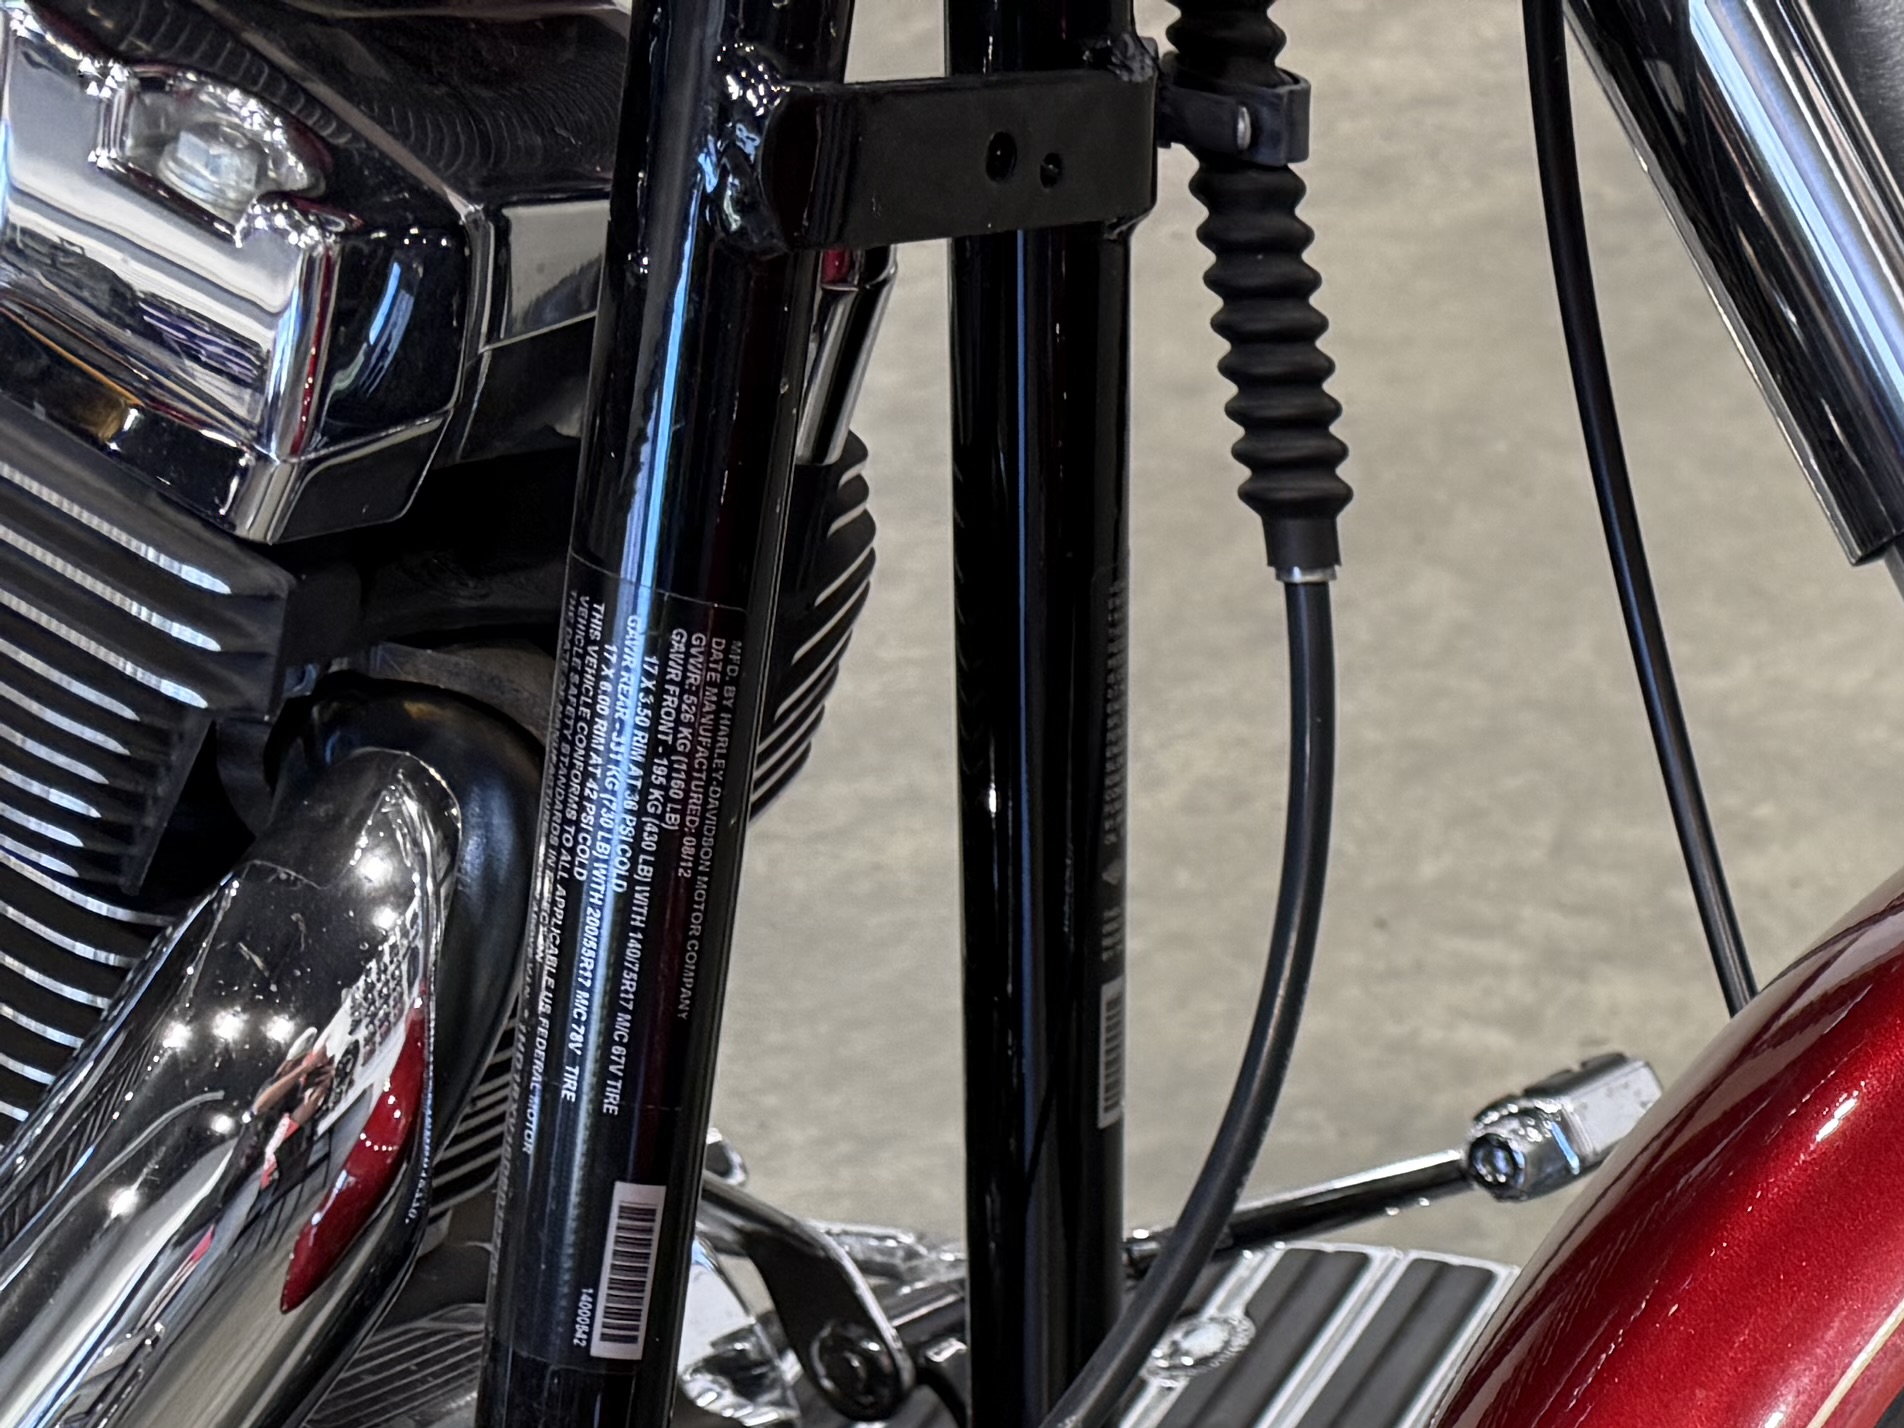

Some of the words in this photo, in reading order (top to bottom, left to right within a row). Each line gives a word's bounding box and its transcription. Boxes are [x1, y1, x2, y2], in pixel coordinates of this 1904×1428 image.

[570, 595, 590, 670] VEHICLE
[587, 601, 604, 640] THIS
[559, 627, 573, 673] DATE
[601, 643, 618, 664] 17
[621, 614, 642, 668] GAWR
[664, 627, 687, 681] GAWR
[599, 664, 615, 678] X
[642, 654, 659, 673] 17
[684, 632, 705, 691] GVWR:
[706, 637, 725, 683] DATE
[724, 639, 742, 681] MFD.
[577, 644, 599, 719] VEHICLE
[613, 670, 634, 719] REAR
[639, 676, 656, 689] X
[721, 685, 735, 708] BY
[561, 671, 580, 740] SAFETY
[634, 692, 654, 727] 3.50
[656, 684, 679, 743] FRONT
[679, 693, 697, 723] 526
[590, 718, 607, 749] RIM
[629, 729, 648, 761] RIM
[675, 726, 692, 752] KG
[563, 721, 588, 819] CONFORMS
[586, 751, 603, 777] AT
[604, 764, 621, 791] KG
[626, 763, 644, 788] AT
[650, 756, 669, 785] 195
[665, 755, 688, 799] (1160
[683, 686, 718, 833] MANUFACTURED:
[547, 742, 571, 846] STANDARDS
[583, 777, 599, 799] 42
[645, 788, 664, 814] KG
[697, 712, 731, 871] HARLEY-DAVIDSON
[579, 801, 597, 830] PSI
[595, 794, 617, 827] (730
[618, 813, 636, 841] PSI
[661, 803, 681, 830] LB)
[560, 824, 575, 848] TO
[590, 830, 612, 860] LB)
[637, 816, 659, 851] (430
[546, 848, 557, 866] IN
[556, 848, 572, 880] ALL
[572, 832, 592, 881] COLD
[611, 843, 632, 892] COLD
[632, 853, 654, 882] LB)
[677, 835, 696, 878] 08/12
[587, 862, 607, 904] WITH
[629, 885, 649, 927] WITH
[688, 875, 708, 937] MOTOR
[540, 883, 567, 988] APPLICABLE
[575, 906, 601, 987] 200/55R17
[617, 931, 642, 1009] 140/75R17
[676, 939, 699, 1020] COMPANY
[571, 989, 589, 1021] M/C
[613, 1012, 631, 1042] M/C
[528, 1016, 549, 1090] FEDERAL
[560, 1064, 579, 1101] TIRE
[602, 1078, 621, 1115] TIRE
[521, 1095, 539, 1154] MOTOR
